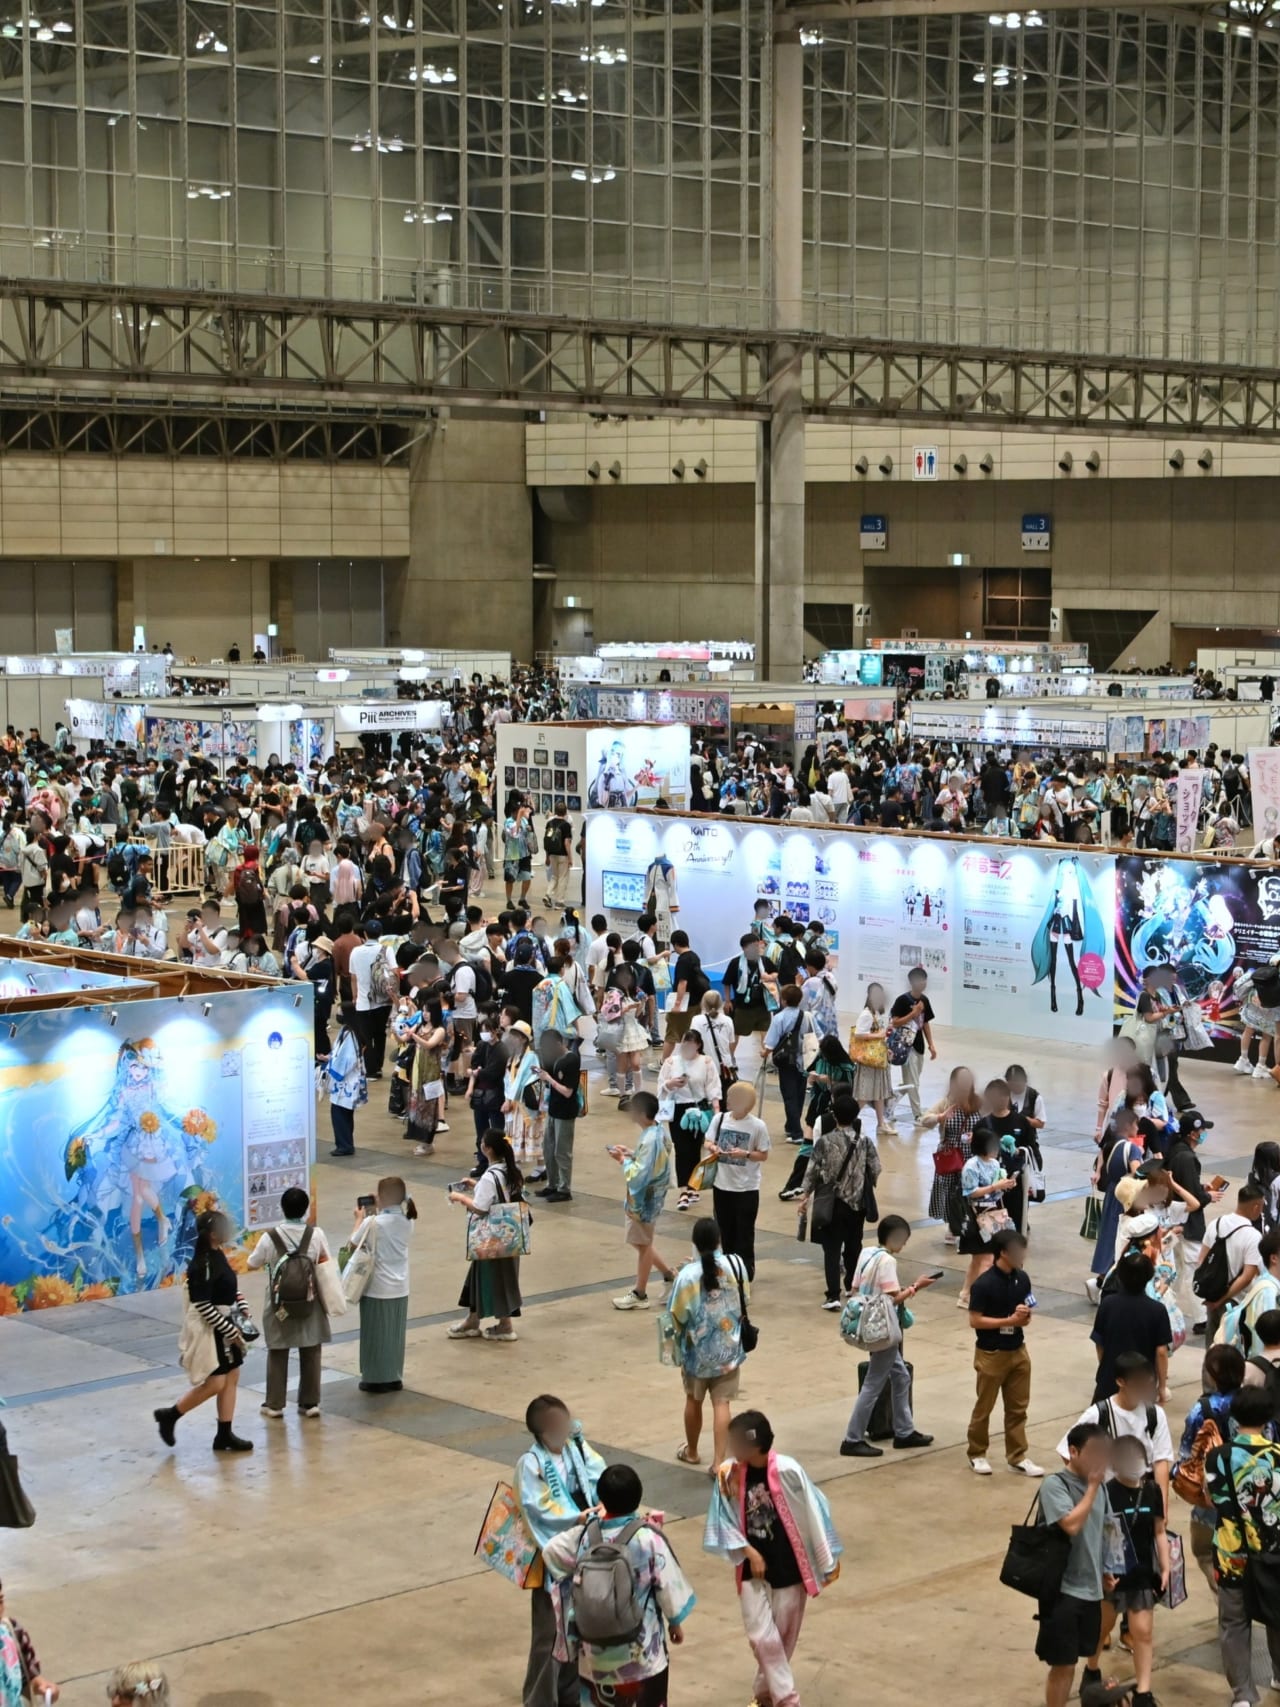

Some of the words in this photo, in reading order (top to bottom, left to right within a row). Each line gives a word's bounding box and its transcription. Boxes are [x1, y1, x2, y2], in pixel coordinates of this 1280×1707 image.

[876, 519, 882, 530] 3
[1039, 519, 1046, 530] 3
[544, 1460, 561, 1498] MIKU
